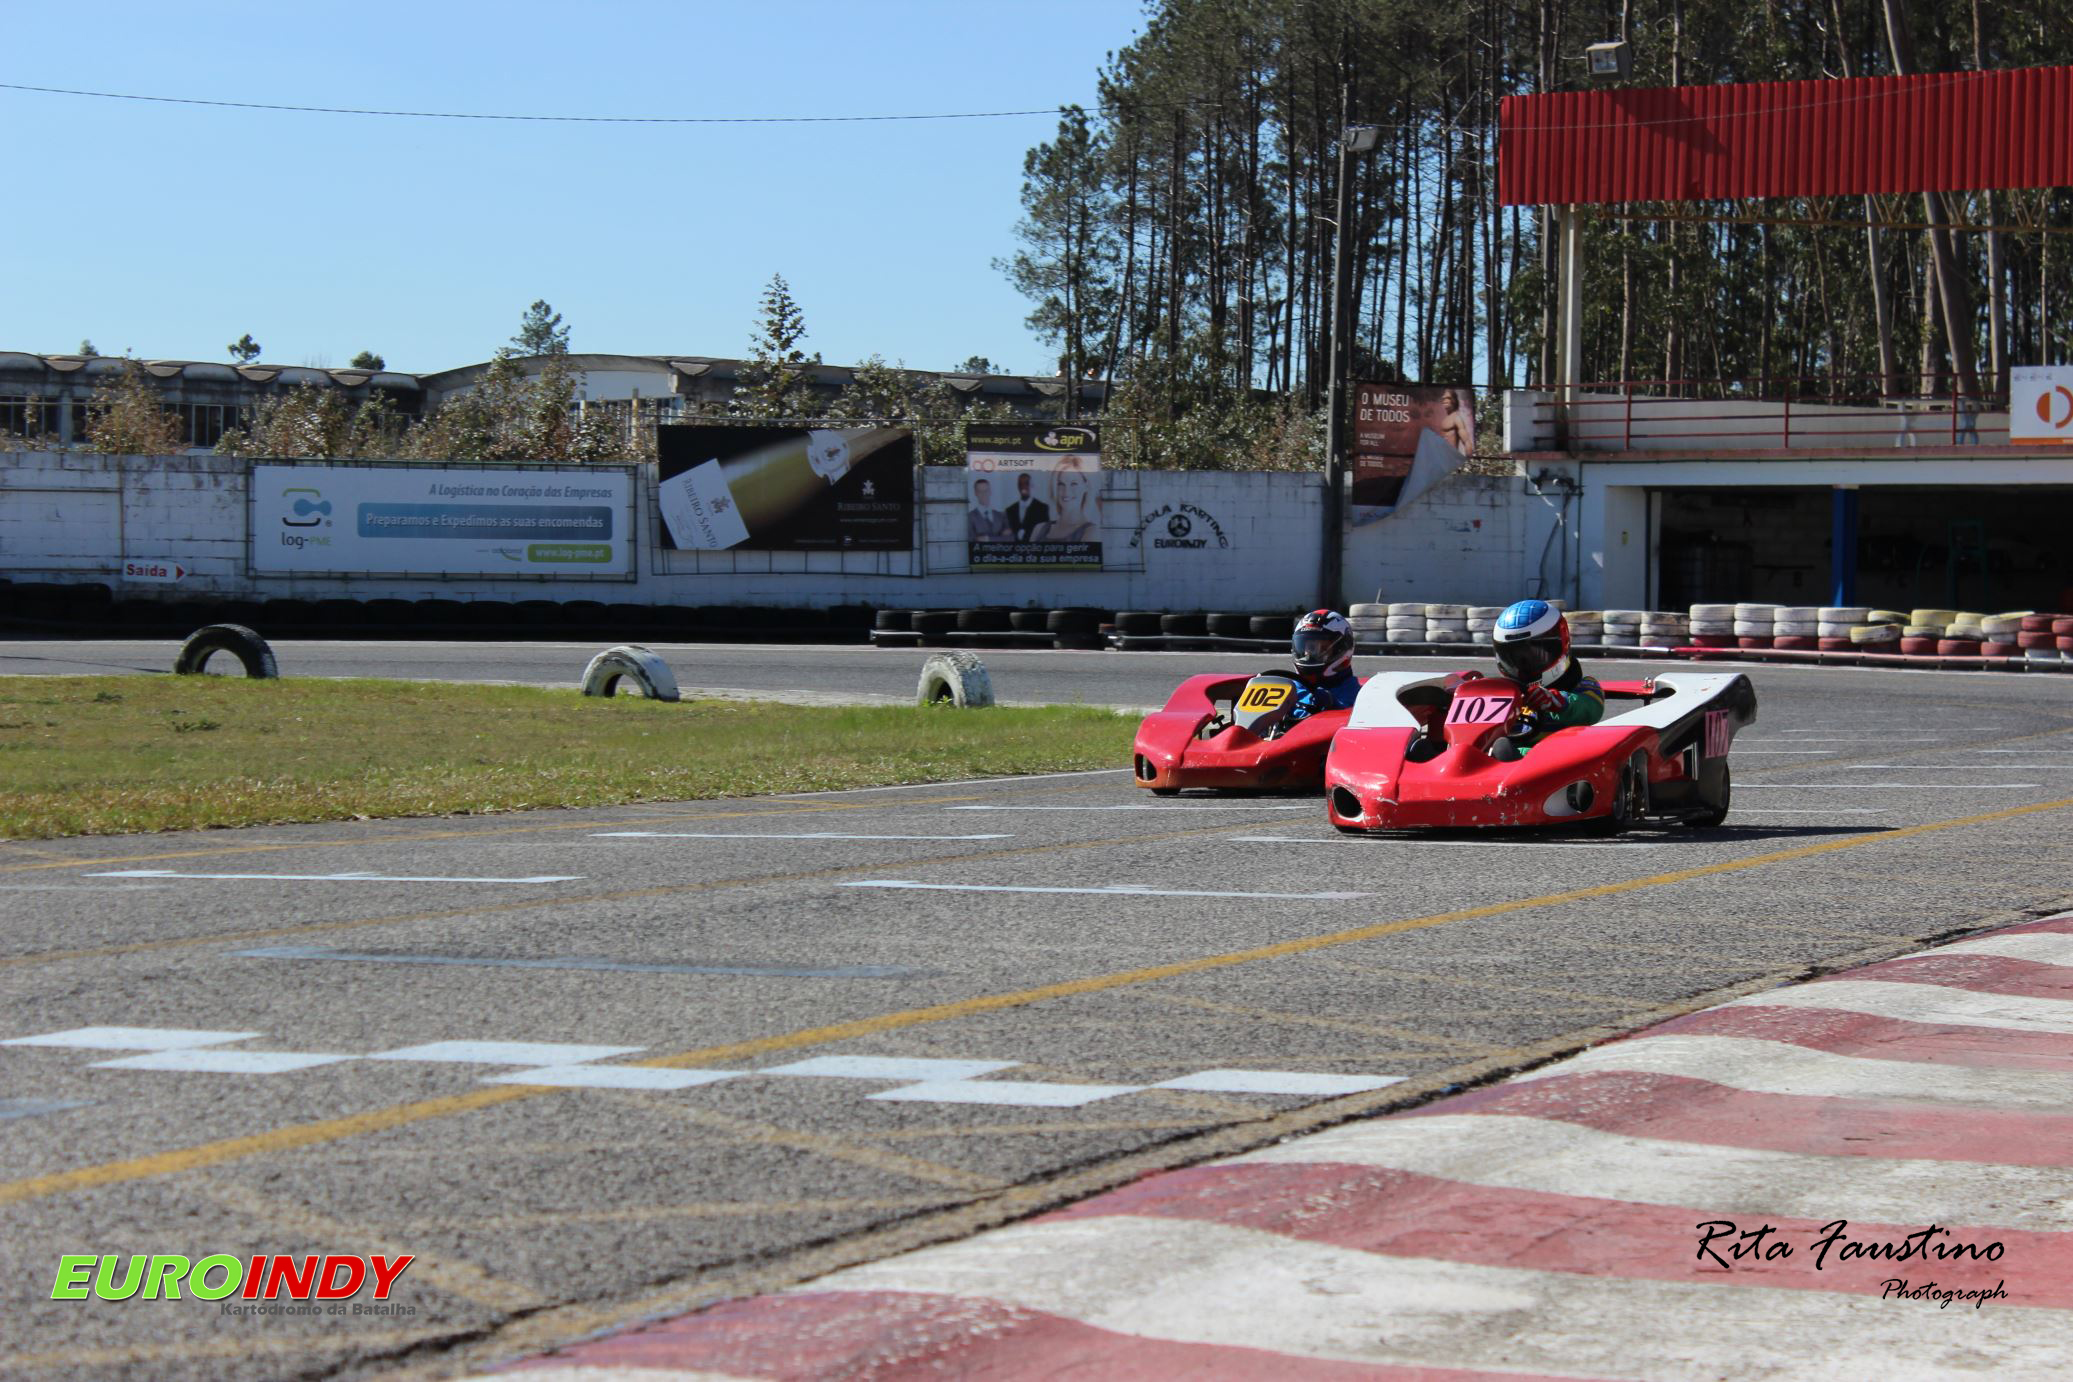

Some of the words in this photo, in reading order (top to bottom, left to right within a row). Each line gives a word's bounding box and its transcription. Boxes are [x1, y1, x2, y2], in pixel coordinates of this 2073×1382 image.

[1361, 392, 1369, 405] O
[1373, 393, 1409, 406] MUSEU
[1360, 408, 1373, 421] DE
[1376, 409, 1411, 423] TODOS
[970, 436, 1022, 445] www.apri.pt
[1060, 433, 1084, 448] apri
[997, 459, 1034, 467] ARTSOFT
[428, 483, 436, 495] A
[486, 487, 500, 496] no
[502, 484, 543, 500] Coração
[544, 485, 562, 497] das
[564, 486, 613, 501] Empresas
[872, 502, 901, 511] SANTO
[366, 513, 430, 528] Preparamos
[432, 517, 439, 526] e
[441, 514, 497, 529] Expedimos
[499, 517, 511, 527] as
[513, 517, 537, 527] suas
[538, 516, 604, 528] encomendas
[1180, 503, 1229, 549] KARTING
[1154, 538, 1208, 549] EUROINDY
[1242, 688, 1286, 706] 102
[1451, 697, 1513, 724] 107
